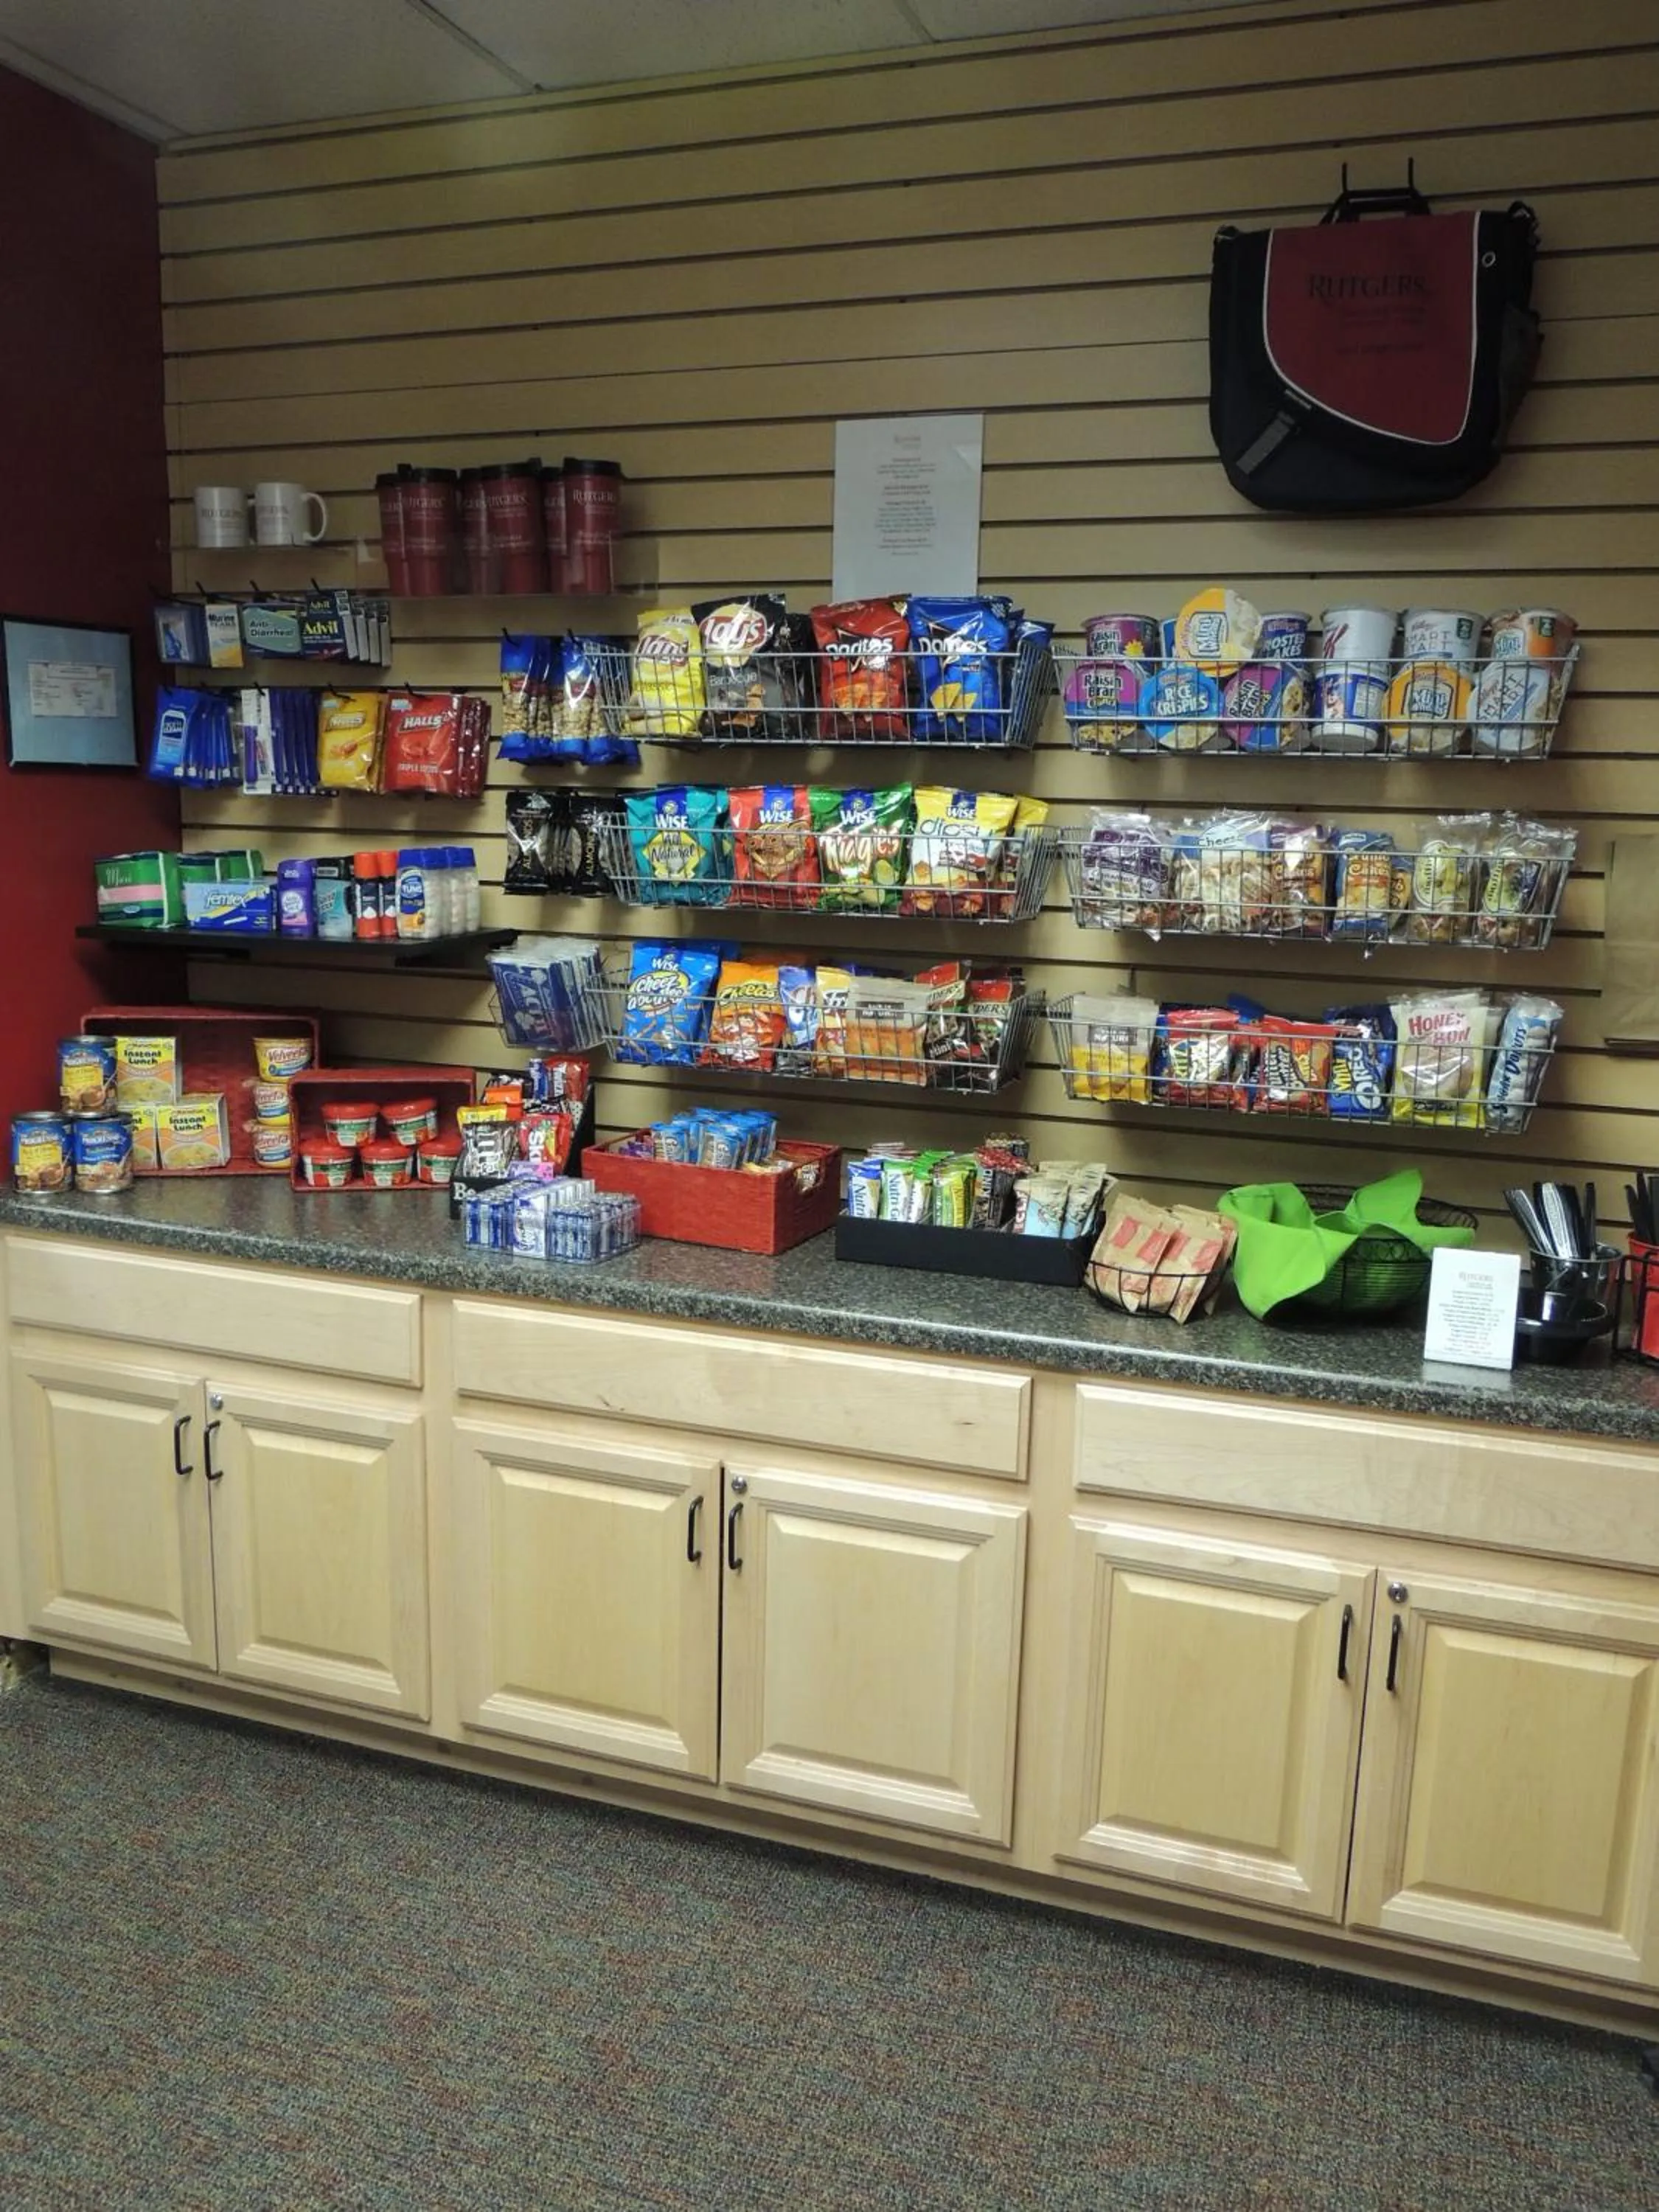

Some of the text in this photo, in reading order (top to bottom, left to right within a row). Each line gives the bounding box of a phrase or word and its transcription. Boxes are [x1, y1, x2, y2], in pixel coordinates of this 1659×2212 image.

[1308, 274, 1427, 301] RUTGERS
[302, 620, 339, 635] Advil
[1263, 633, 1304, 651] ROSTED
[1266, 646, 1301, 658] LAKES
[403, 715, 442, 729] HALLS
[759, 810, 795, 824] WISE
[840, 810, 876, 826] WISE
[947, 805, 977, 818] WISE
[655, 813, 690, 829] WISE
[650, 844, 695, 863] Natural
[402, 885, 423, 894] TUMS
[1408, 1012, 1465, 1035] HONEY
[1433, 1026, 1470, 1046] BUN
[123, 1049, 162, 1058] Instant
[128, 1057, 159, 1065] Lunch
[1348, 1046, 1381, 1110] OREO
[169, 1116, 206, 1125] Instant
[173, 1124, 204, 1133] Lunch
[982, 1168, 993, 1198] KIND
